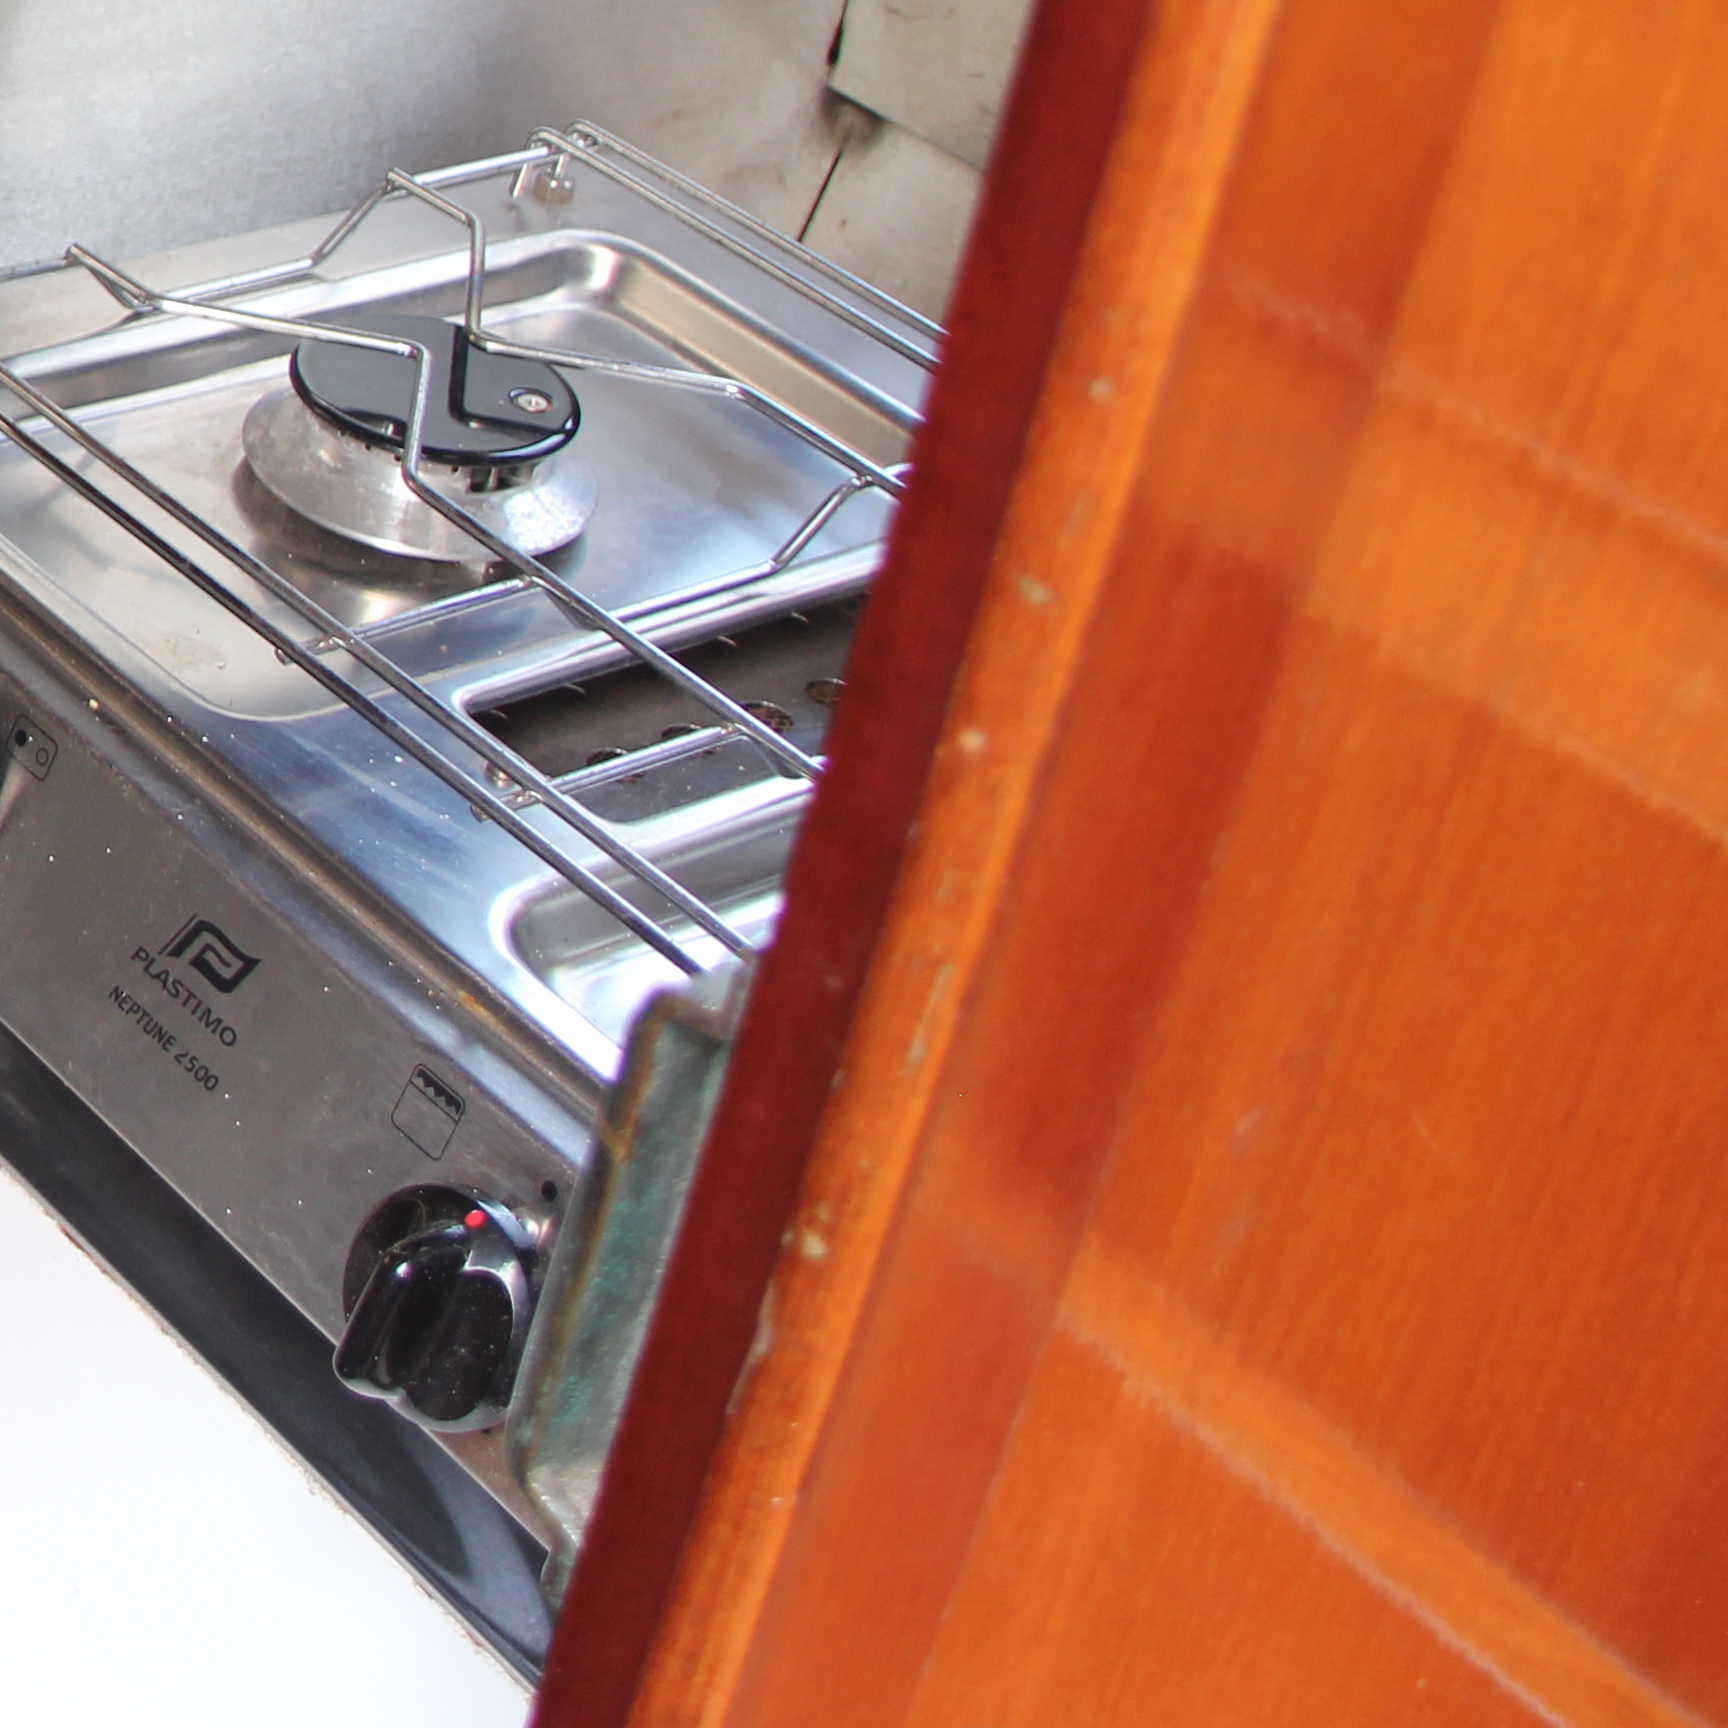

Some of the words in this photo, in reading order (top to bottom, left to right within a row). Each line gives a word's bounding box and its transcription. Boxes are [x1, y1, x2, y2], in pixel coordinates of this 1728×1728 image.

[108, 984, 177, 1052] NEPTUNE
[173, 1048, 220, 1092] 2500
[130, 946, 238, 1048] PLASTIMO
